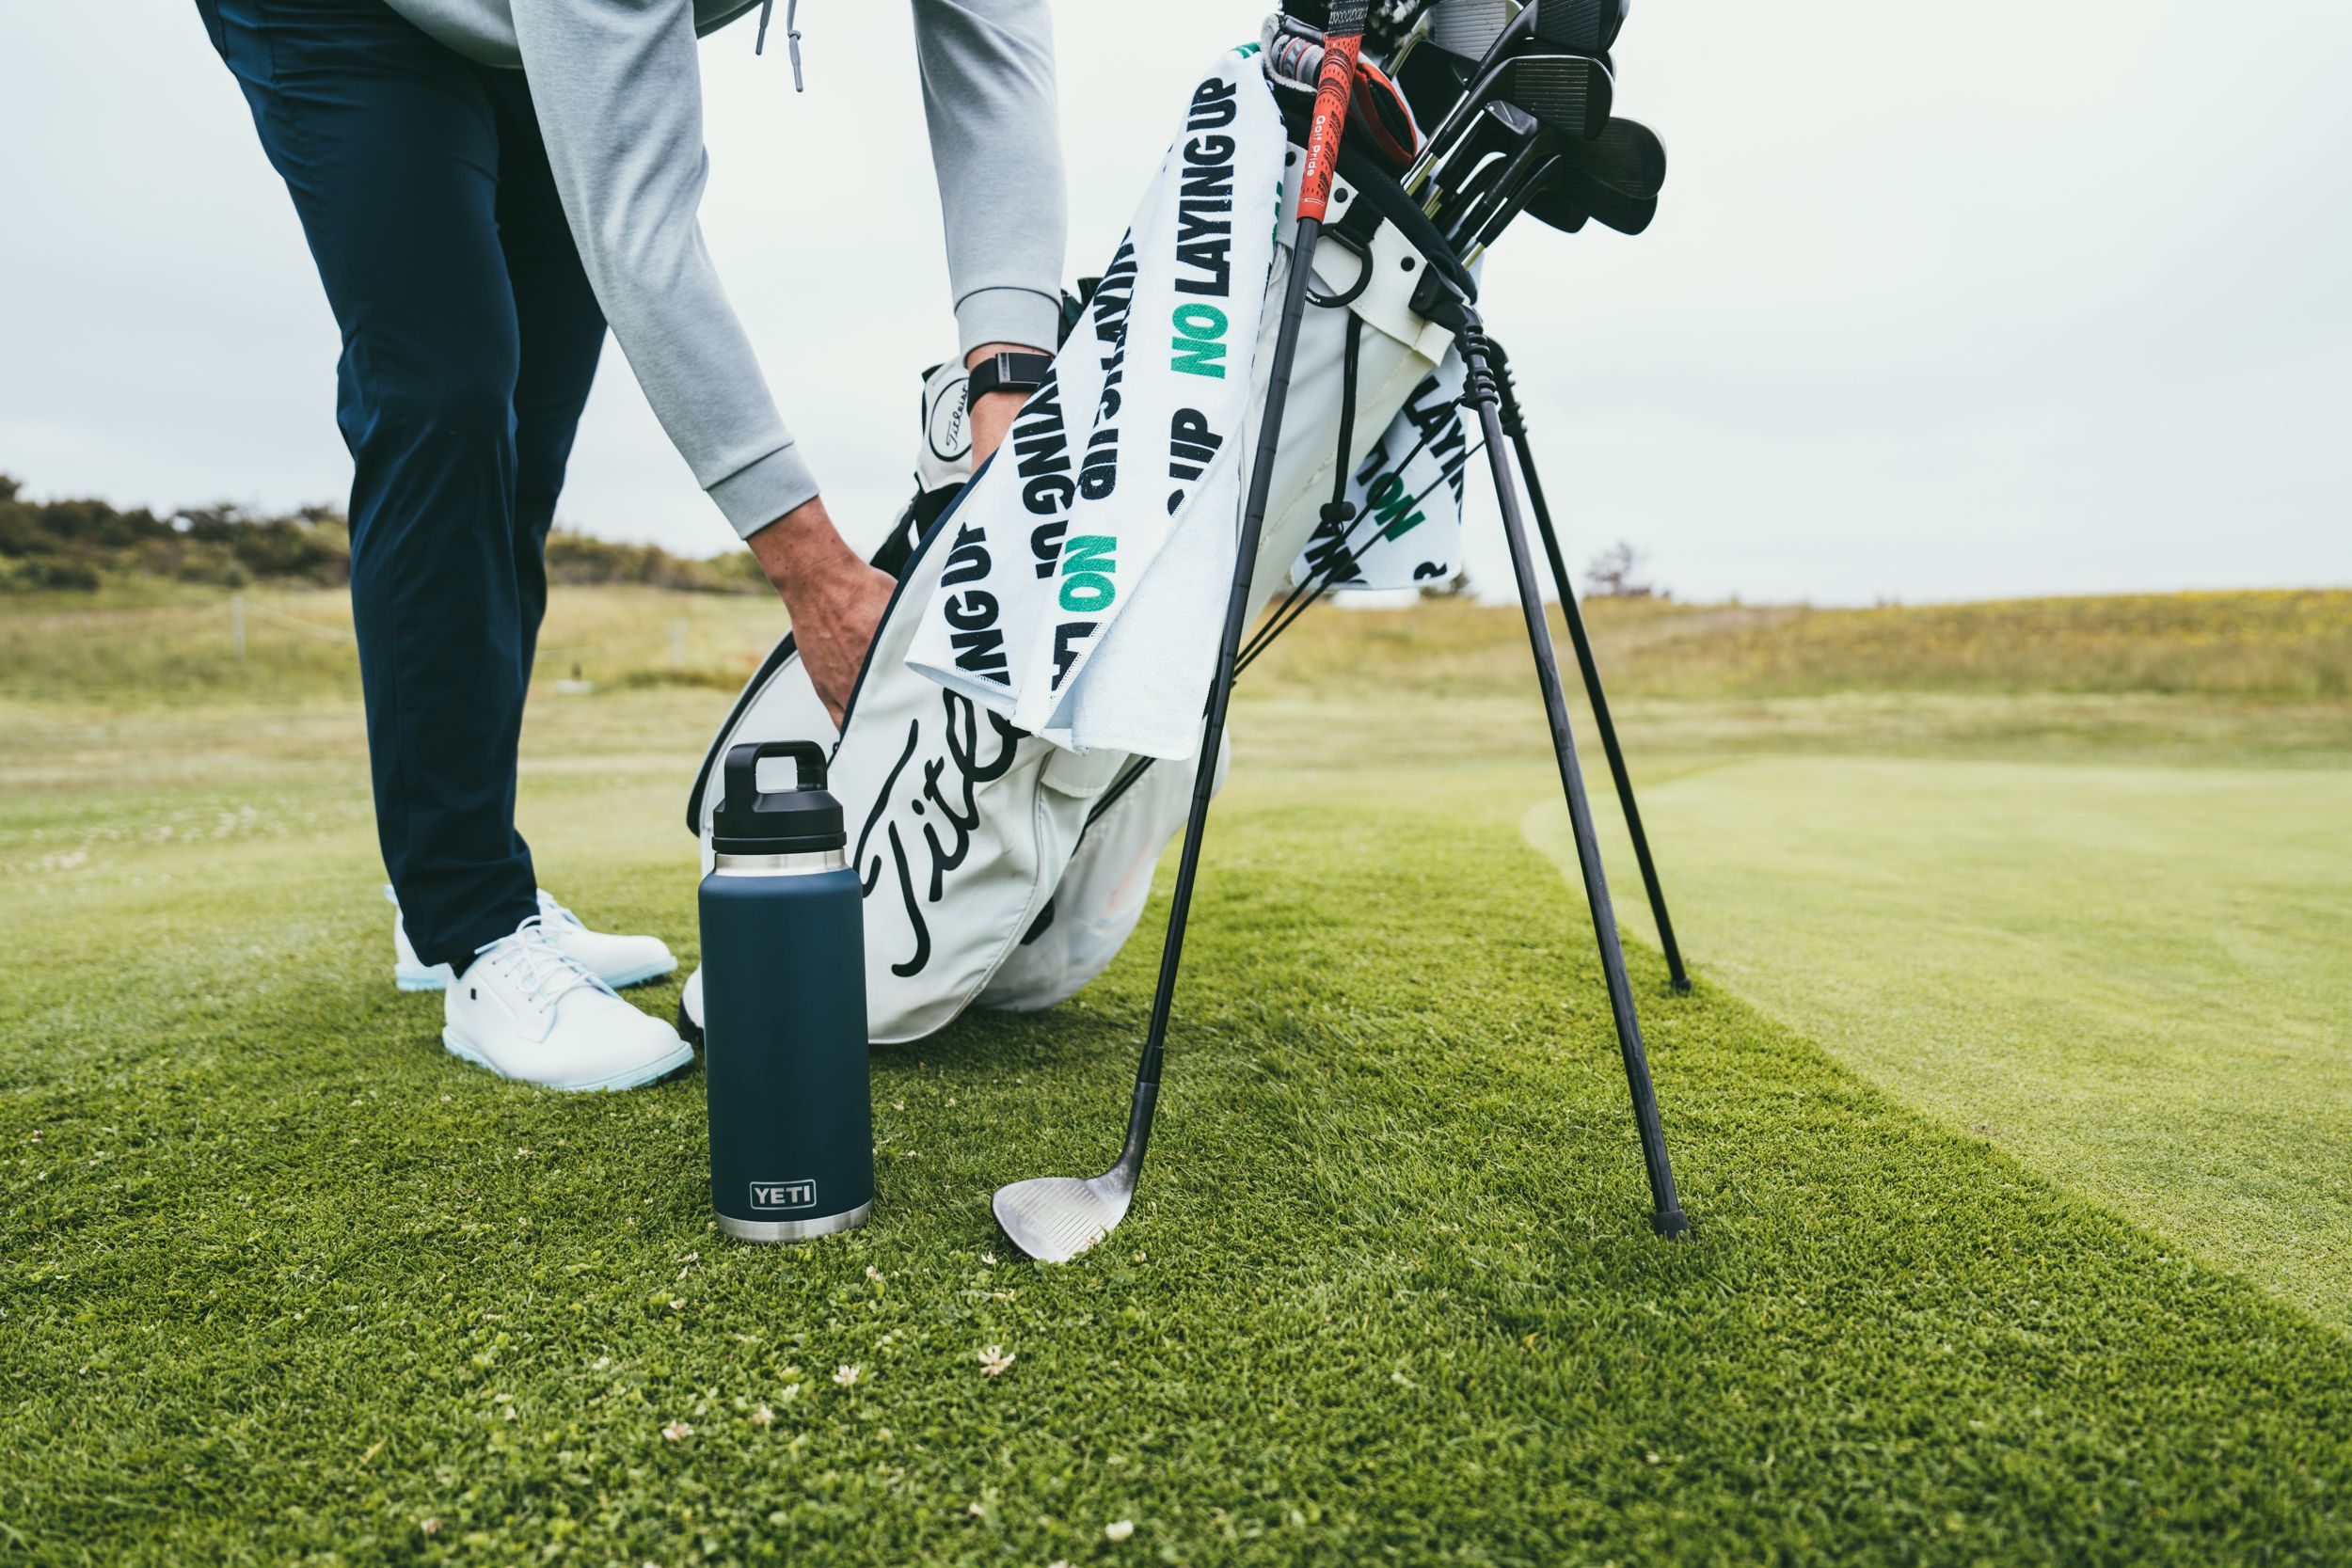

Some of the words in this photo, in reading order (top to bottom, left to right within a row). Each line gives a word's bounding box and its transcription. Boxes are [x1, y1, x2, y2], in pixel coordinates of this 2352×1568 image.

[1186, 77, 1237, 132] UP
[1312, 115, 1327, 142] Golf
[1307, 144, 1321, 177] Pride
[1174, 135, 1236, 297] LAYING
[1170, 303, 1229, 379] NO
[1058, 535, 1117, 612] NO
[754, 1185, 811, 1204] YETI
